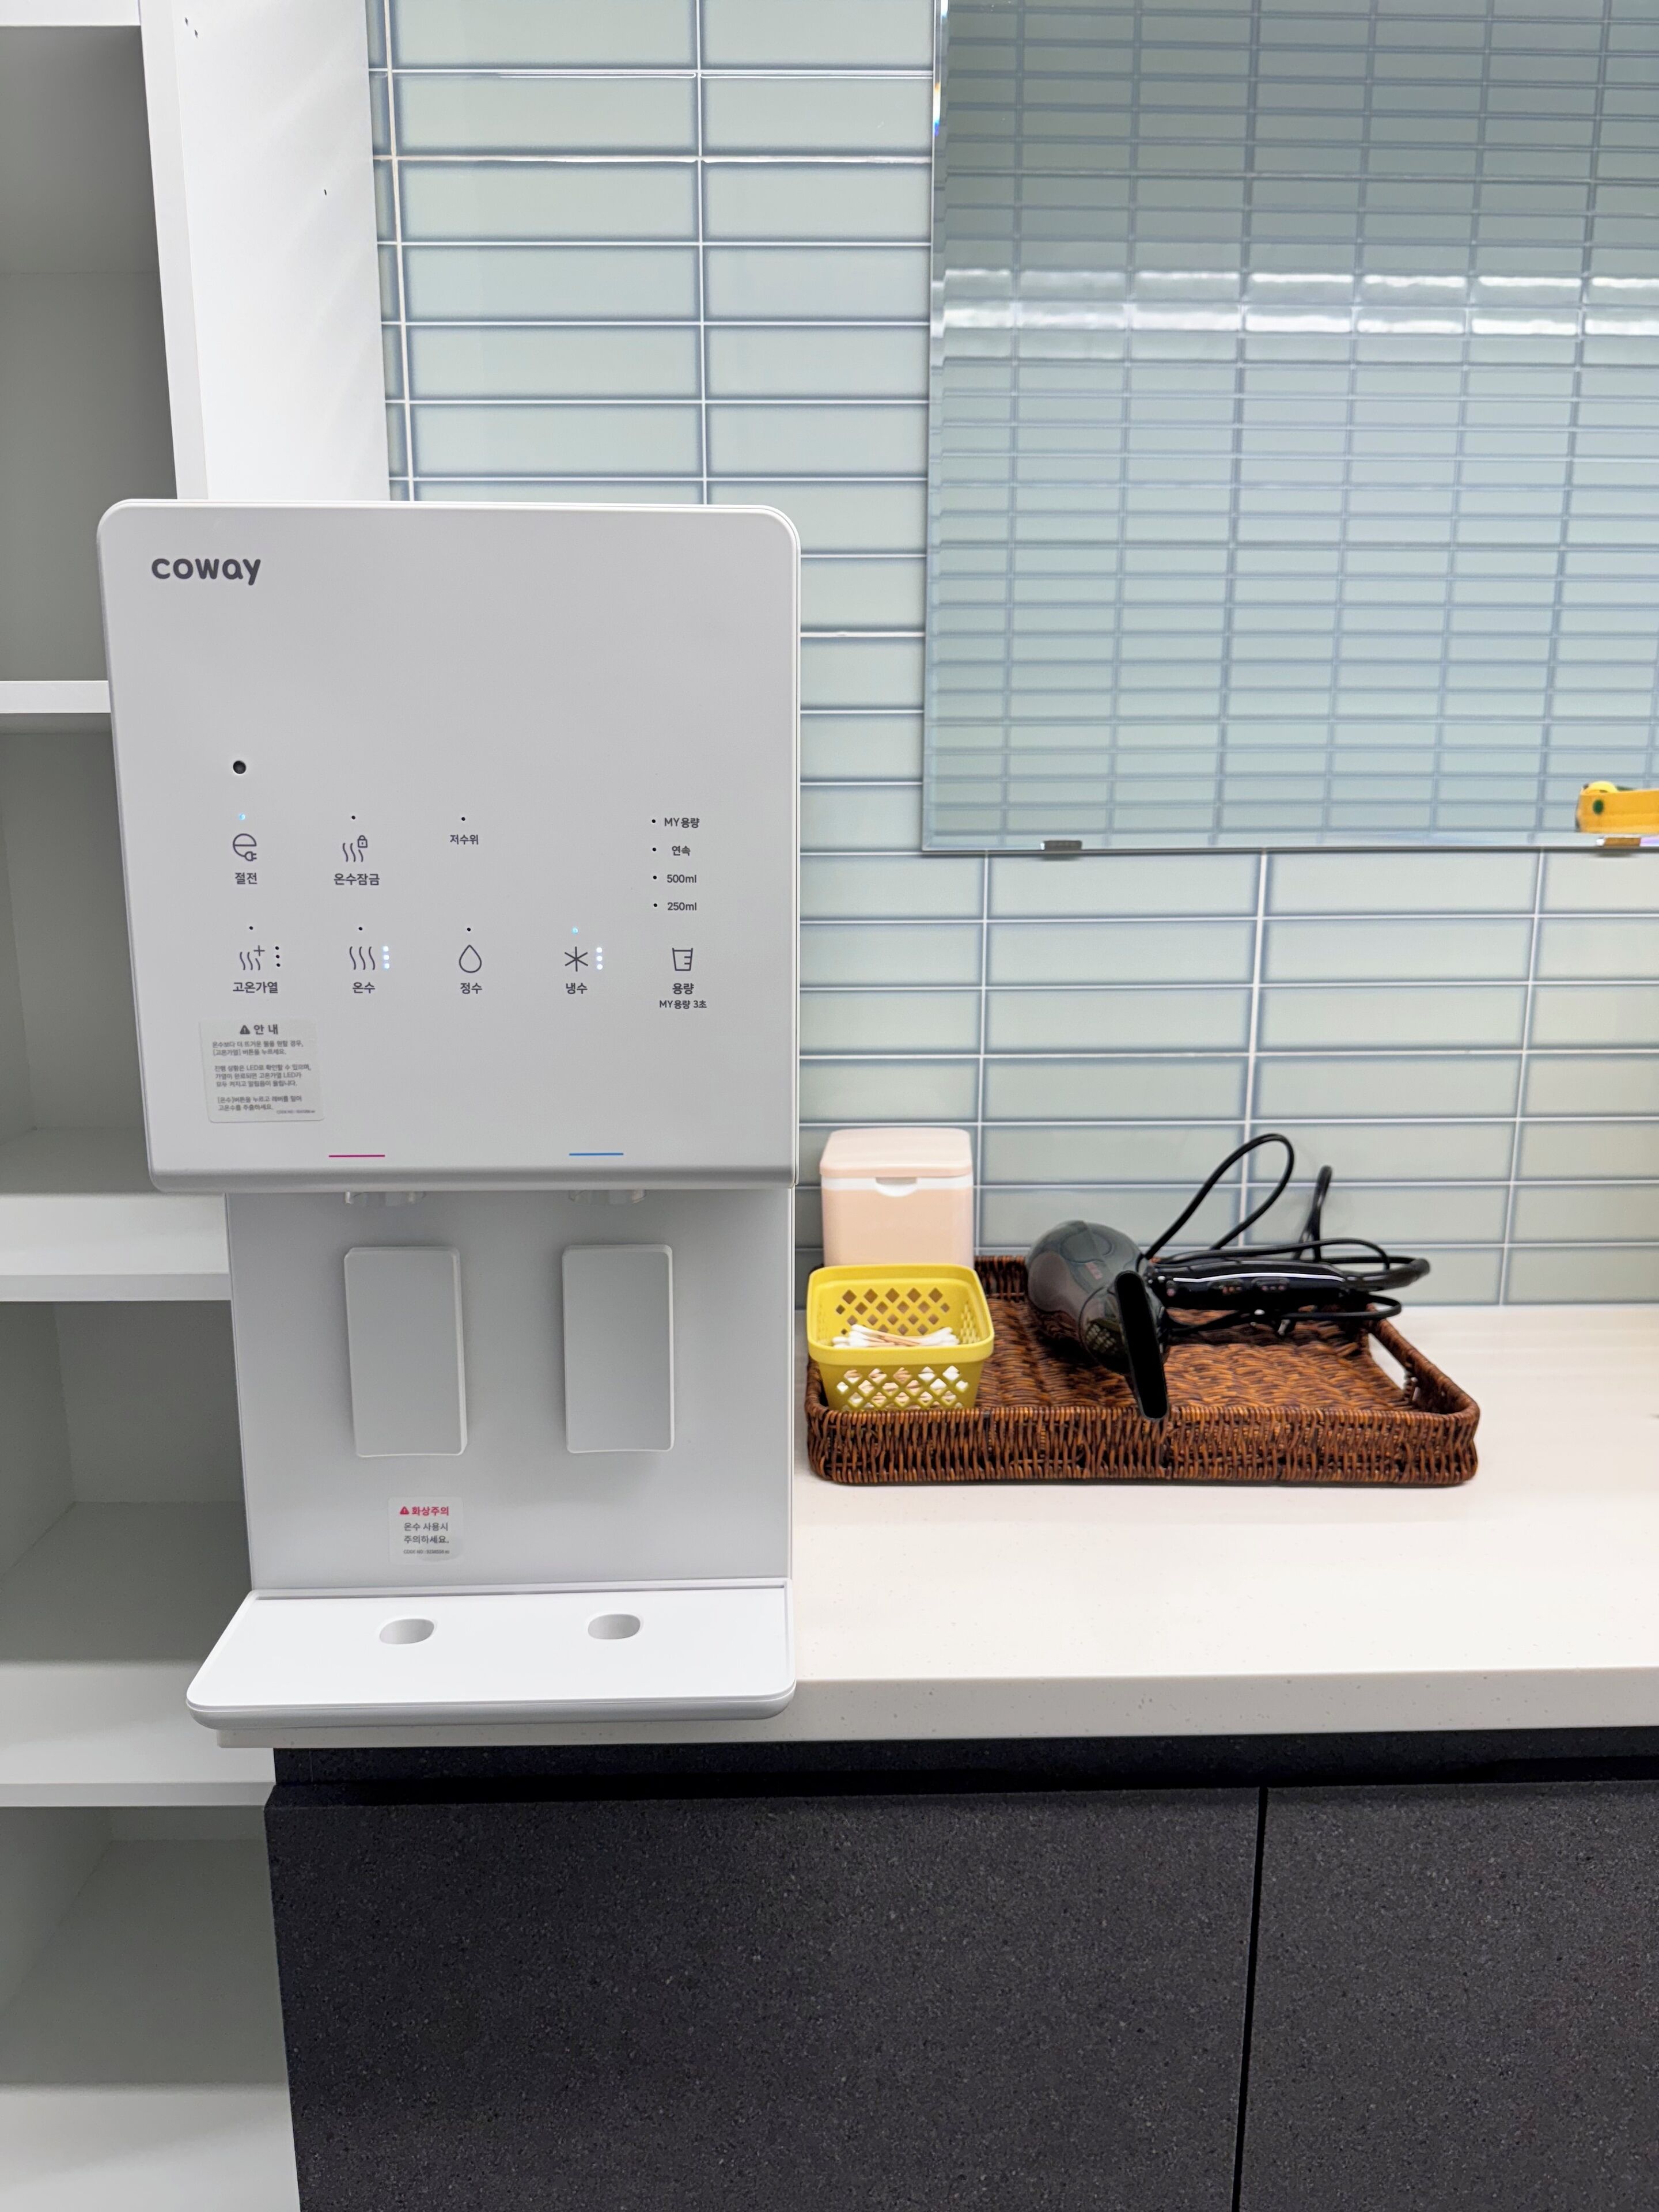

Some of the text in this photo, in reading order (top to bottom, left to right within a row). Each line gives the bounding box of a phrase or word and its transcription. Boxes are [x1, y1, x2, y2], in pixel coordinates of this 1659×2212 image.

[151, 558, 262, 586] coway
[664, 817, 700, 828] MY용량
[449, 834, 479, 845] 저수위
[671, 845, 691, 857] 연속
[234, 872, 258, 885] 절전
[333, 873, 380, 886] 온수잠금
[666, 874, 697, 884] 500ml
[667, 902, 698, 911] 250ml
[232, 982, 279, 994] 고온가열
[352, 982, 376, 994] 온수
[460, 982, 483, 994] 정수
[565, 983, 588, 995] 냉수
[672, 983, 695, 995] 용량
[659, 1000, 707, 1010] MY용량 3초
[411, 1506, 449, 1516] 화상주의
[403, 1522, 449, 1532] 온수 사용시
[403, 1535, 449, 1544] 주의하세요.
